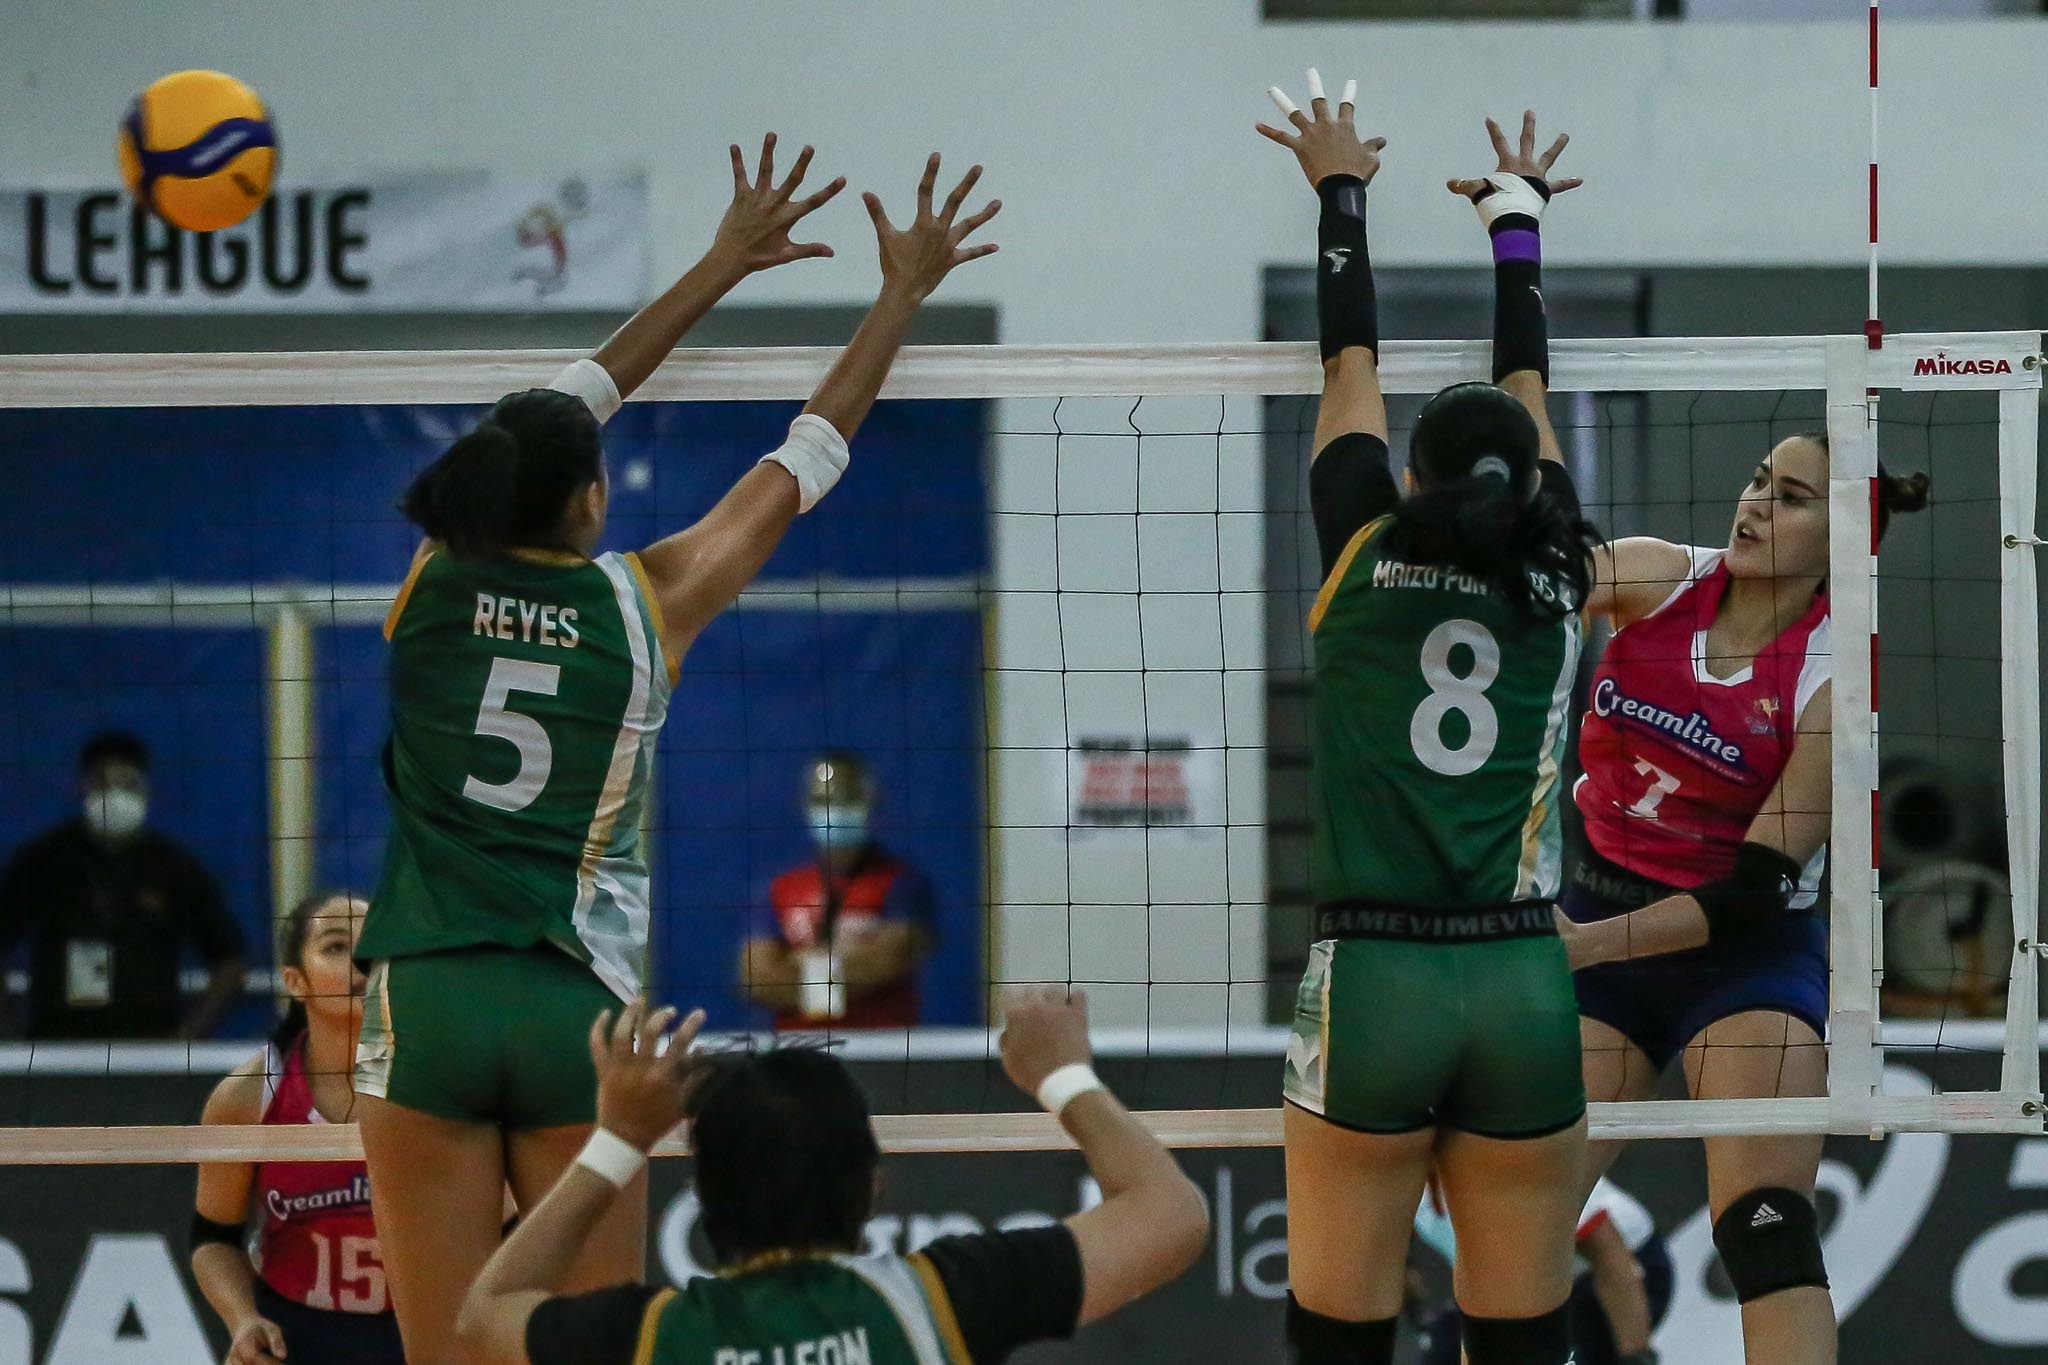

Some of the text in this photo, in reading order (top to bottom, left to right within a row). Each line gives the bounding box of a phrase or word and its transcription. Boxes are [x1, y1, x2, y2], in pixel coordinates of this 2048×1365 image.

[26, 191, 373, 297] LEAGUE
[473, 592, 581, 649] REYES
[462, 656, 561, 812] 5
[1410, 618, 1500, 776] 8
[1594, 678, 1741, 763] Creamline
[1612, 754, 1682, 821] 7
[267, 1176, 372, 1222] Creamli
[305, 1231, 387, 1316] 15
